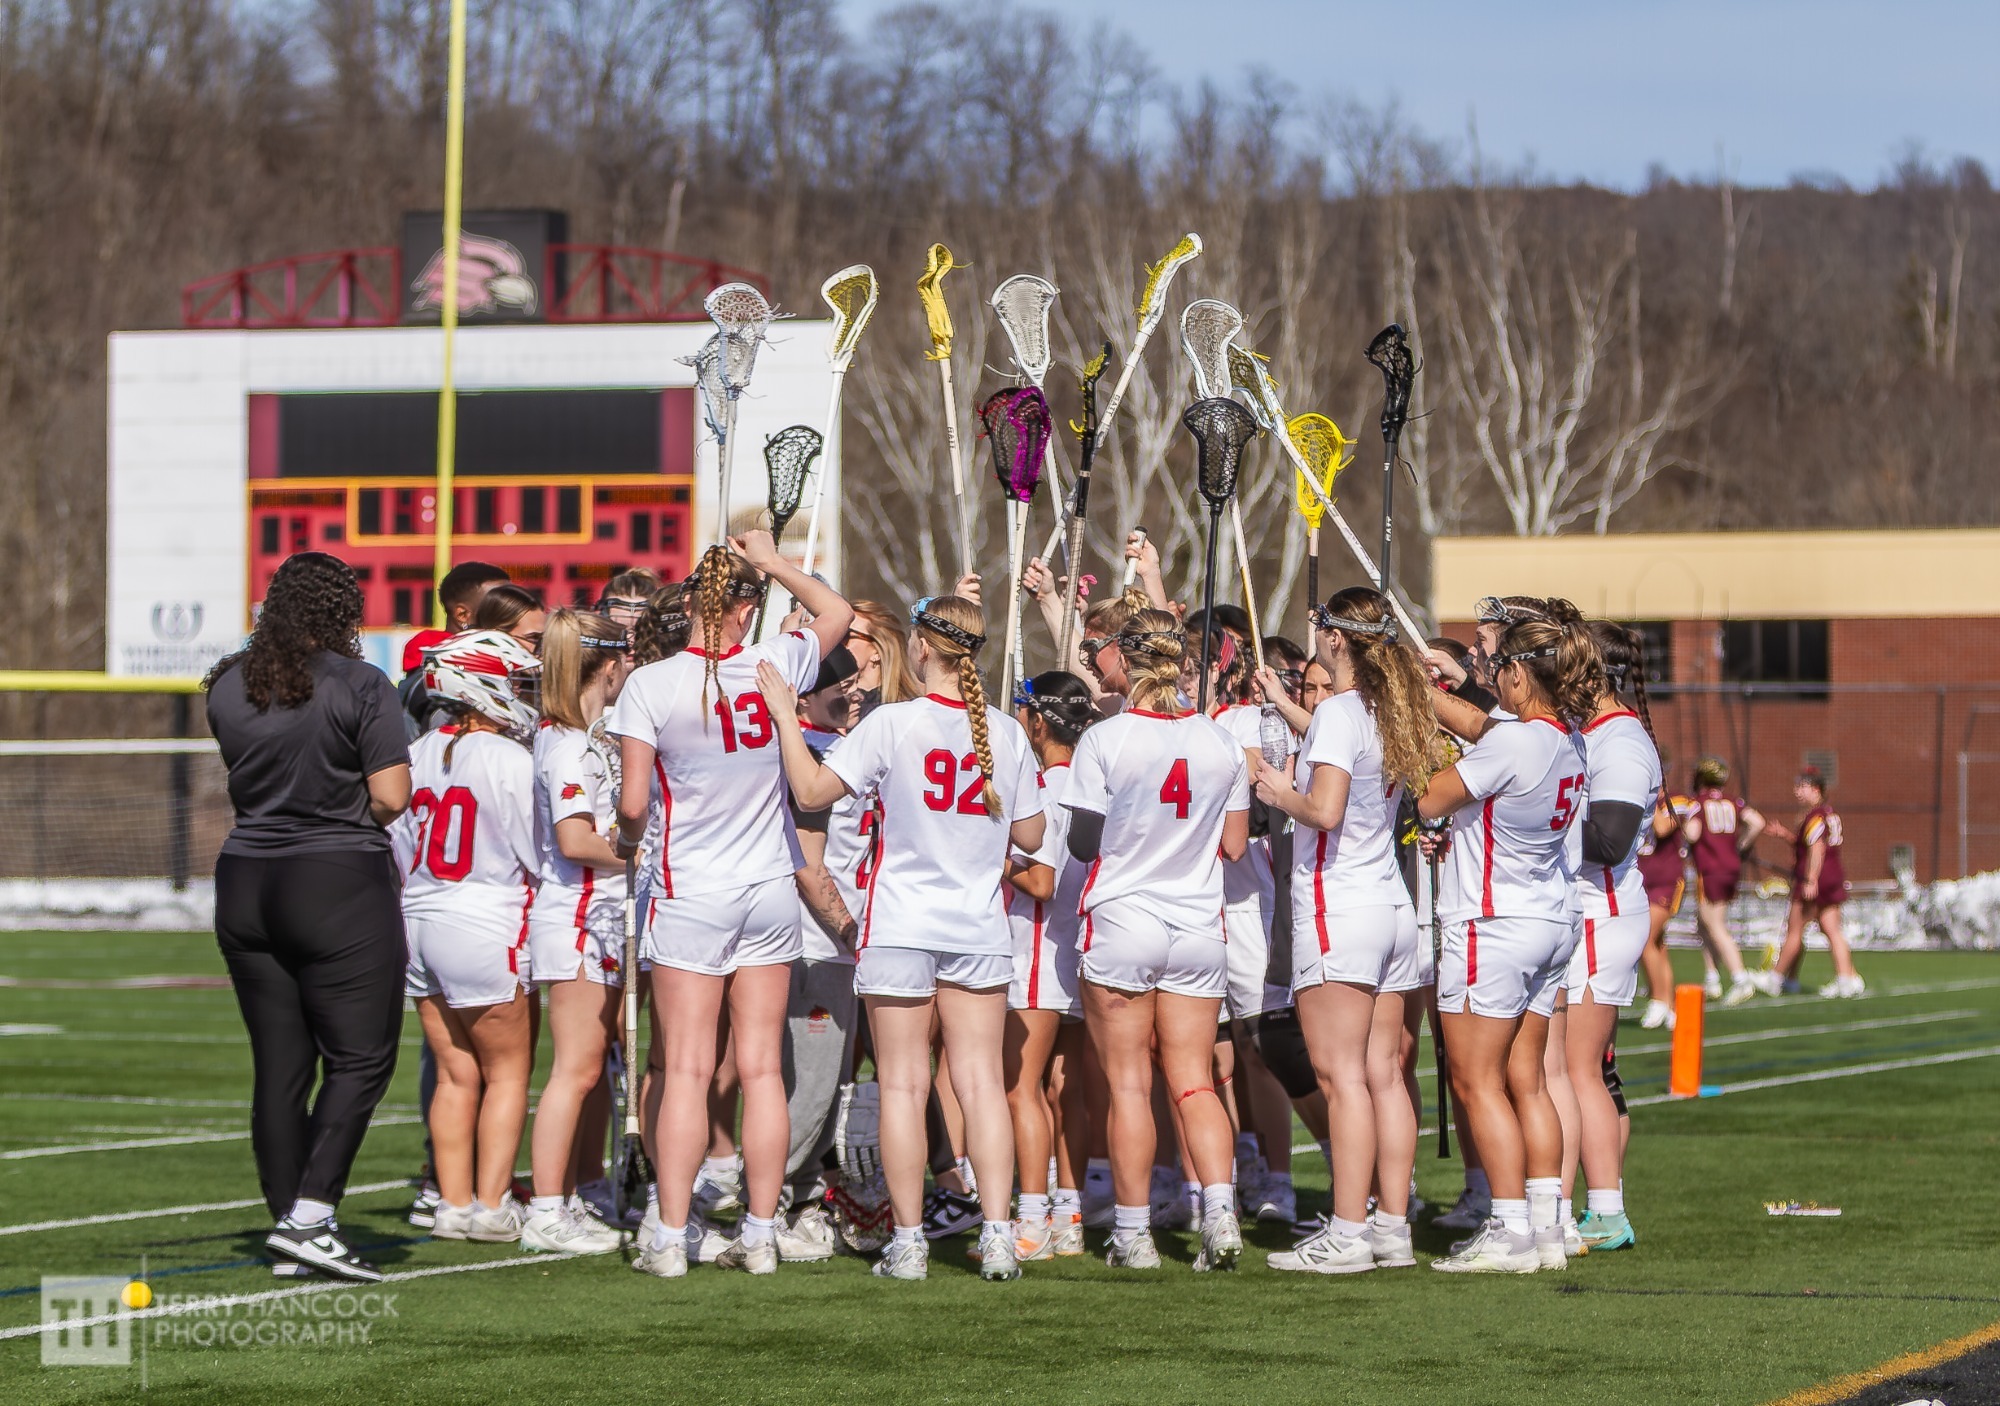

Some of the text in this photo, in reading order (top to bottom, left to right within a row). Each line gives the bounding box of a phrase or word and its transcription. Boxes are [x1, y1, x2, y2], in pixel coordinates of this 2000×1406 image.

[661, 612, 683, 621] STX
[667, 619, 689, 631] STX
[921, 613, 943, 625] STX
[945, 624, 968, 638] STX
[1511, 651, 1537, 661] STX
[1041, 695, 1063, 704] STX
[714, 691, 773, 754] 13
[1044, 709, 1066, 726] STX
[923, 748, 990, 816] 92
[1159, 758, 1192, 820] 4
